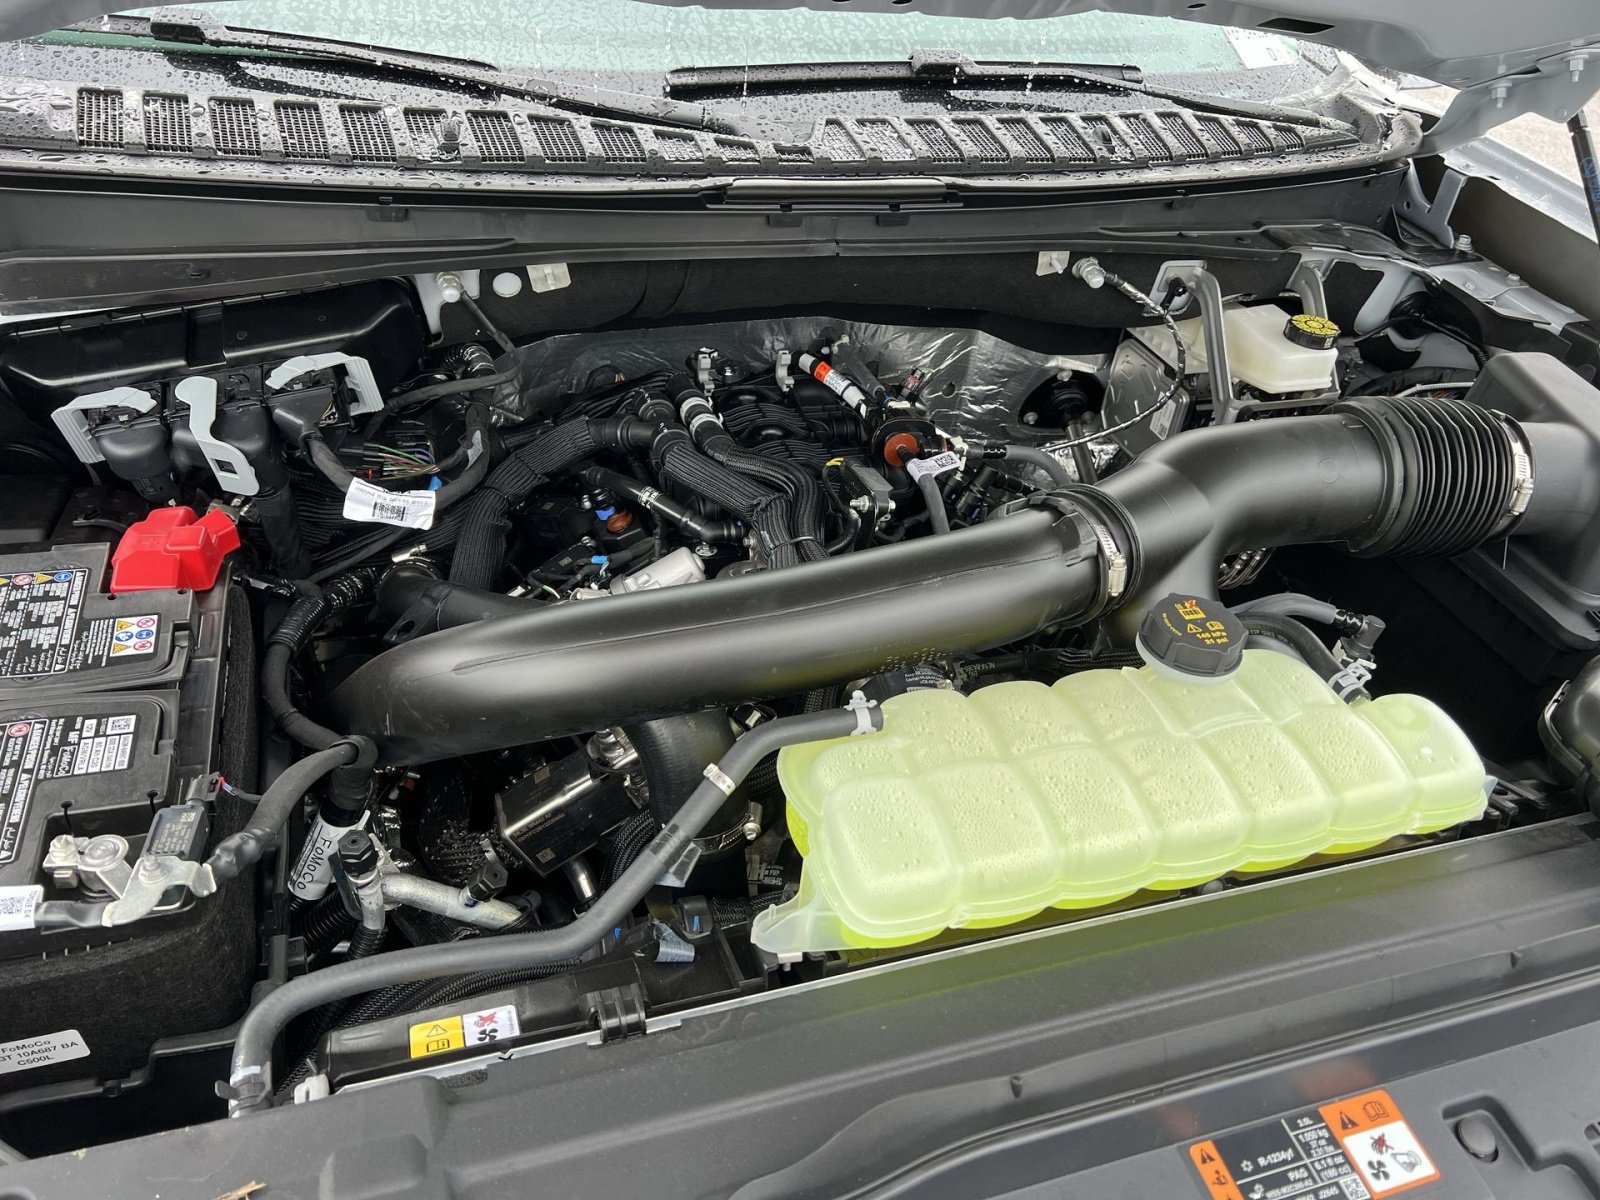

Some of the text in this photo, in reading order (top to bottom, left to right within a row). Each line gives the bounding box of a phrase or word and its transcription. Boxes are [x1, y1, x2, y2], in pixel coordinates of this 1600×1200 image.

[58, 746, 74, 776] FoMoCo
[1, 1040, 51, 1054] FoMoCo
[61, 1041, 79, 1049] BA
[1287, 1167, 1309, 1182] PAG
